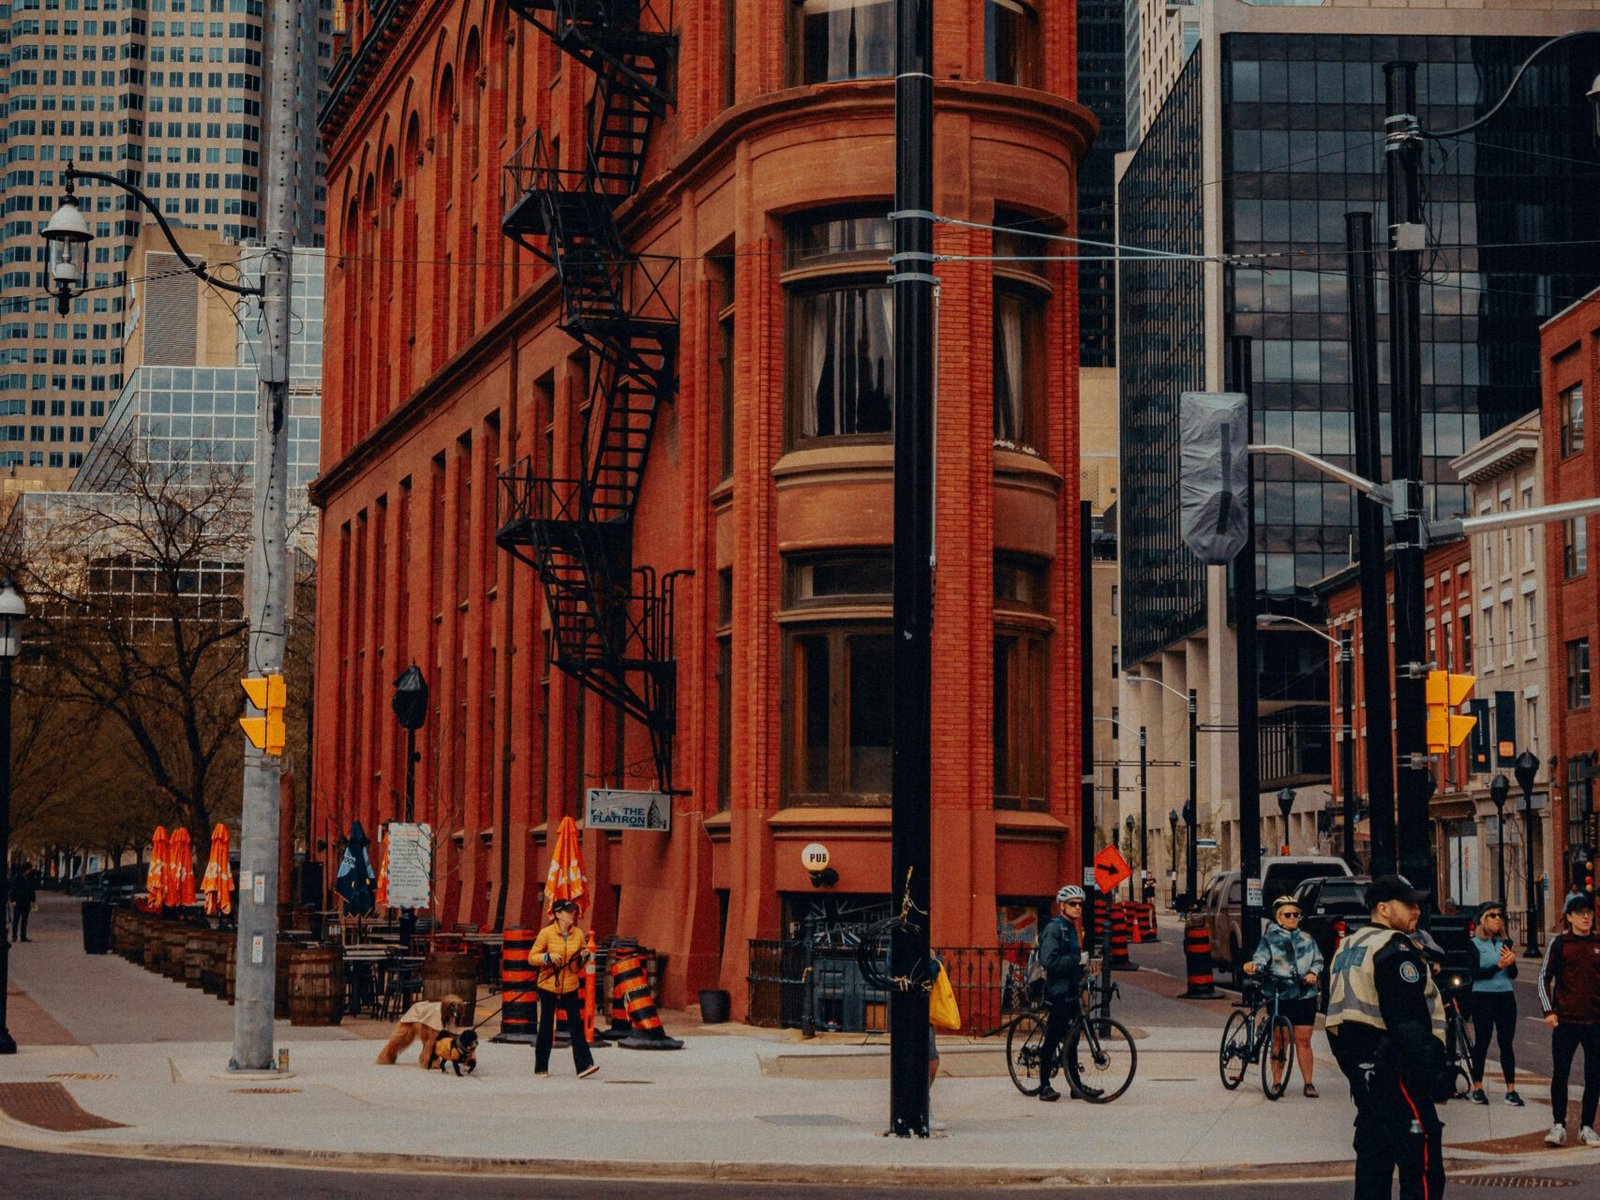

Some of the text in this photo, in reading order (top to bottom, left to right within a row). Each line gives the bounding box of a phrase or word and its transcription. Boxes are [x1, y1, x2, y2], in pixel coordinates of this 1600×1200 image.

[623, 807, 645, 815] THE
[592, 815, 645, 824] FLATIRON
[809, 853, 827, 863] PUB
[816, 921, 869, 933] FLATIR
